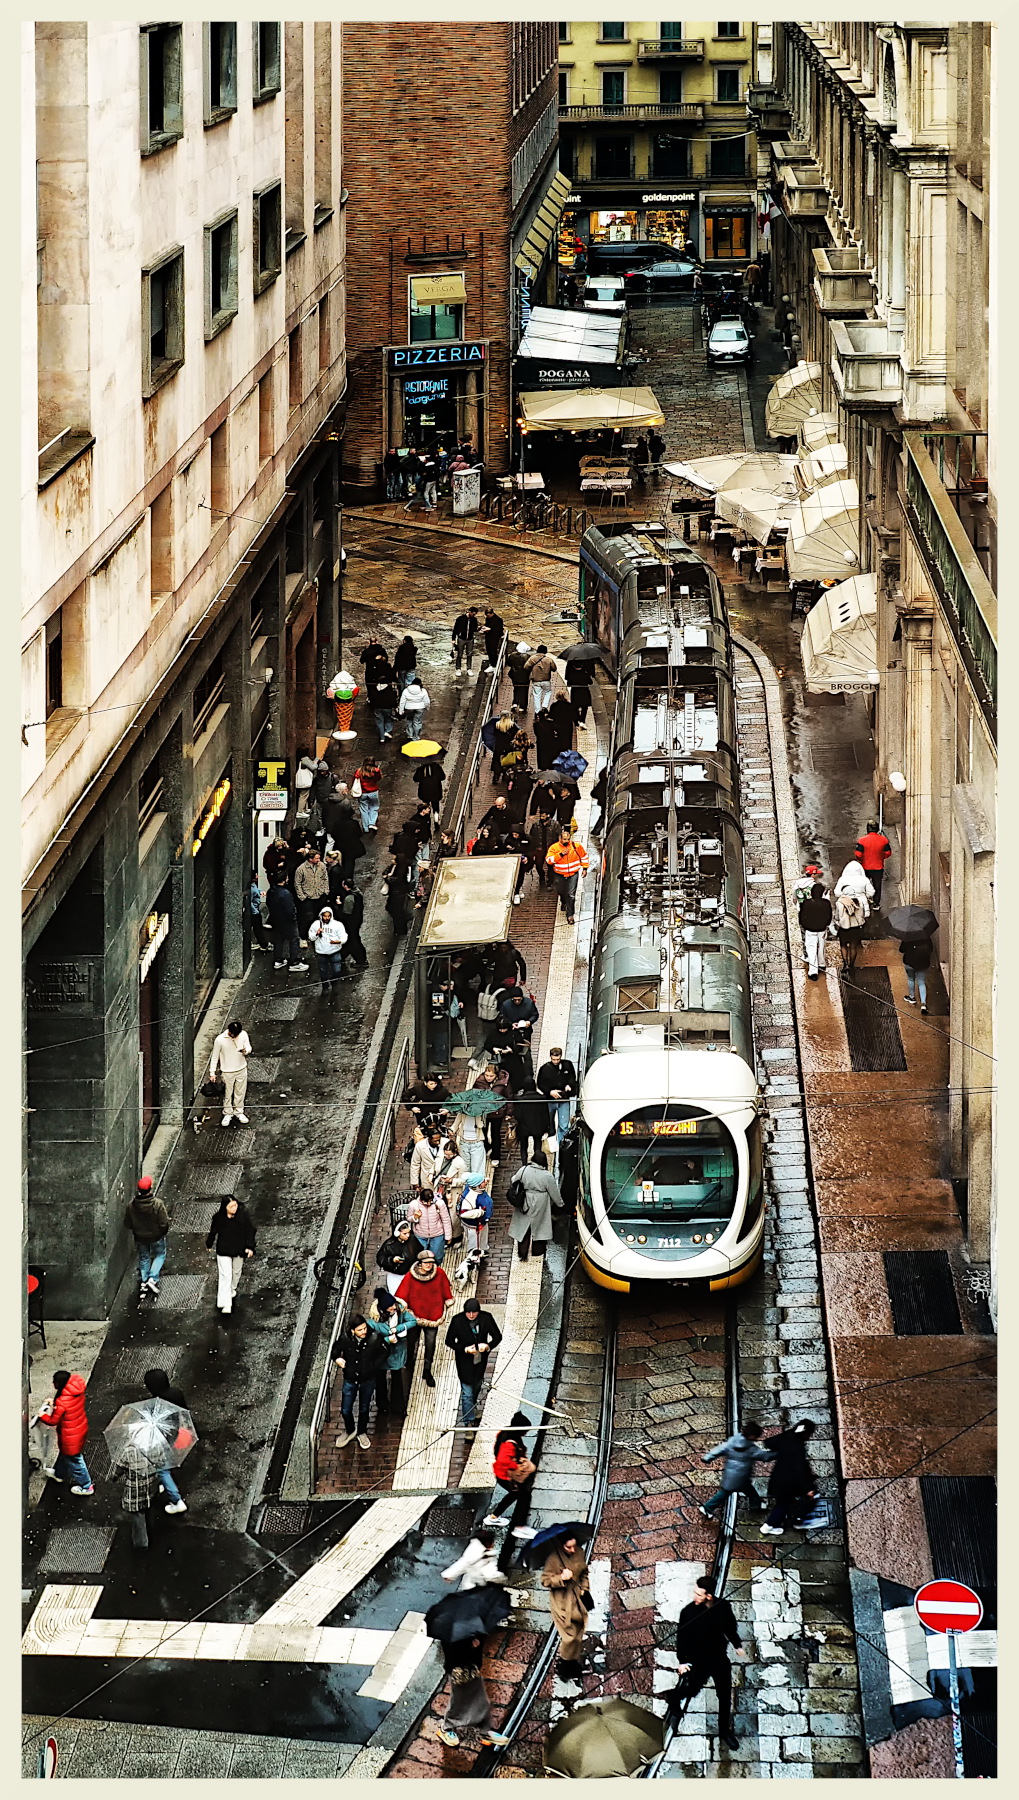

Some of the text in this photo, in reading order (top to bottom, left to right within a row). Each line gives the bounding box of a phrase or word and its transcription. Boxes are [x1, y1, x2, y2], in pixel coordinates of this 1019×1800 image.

[642, 193, 695, 203] goldenpoint
[394, 345, 482, 365] PIZZERIA
[539, 369, 590, 378] DOGANA
[404, 379, 448, 393] RISTORANTE
[259, 762, 286, 783] T
[620, 1121, 634, 1135] 15
[658, 1238, 681, 1248] 7112
